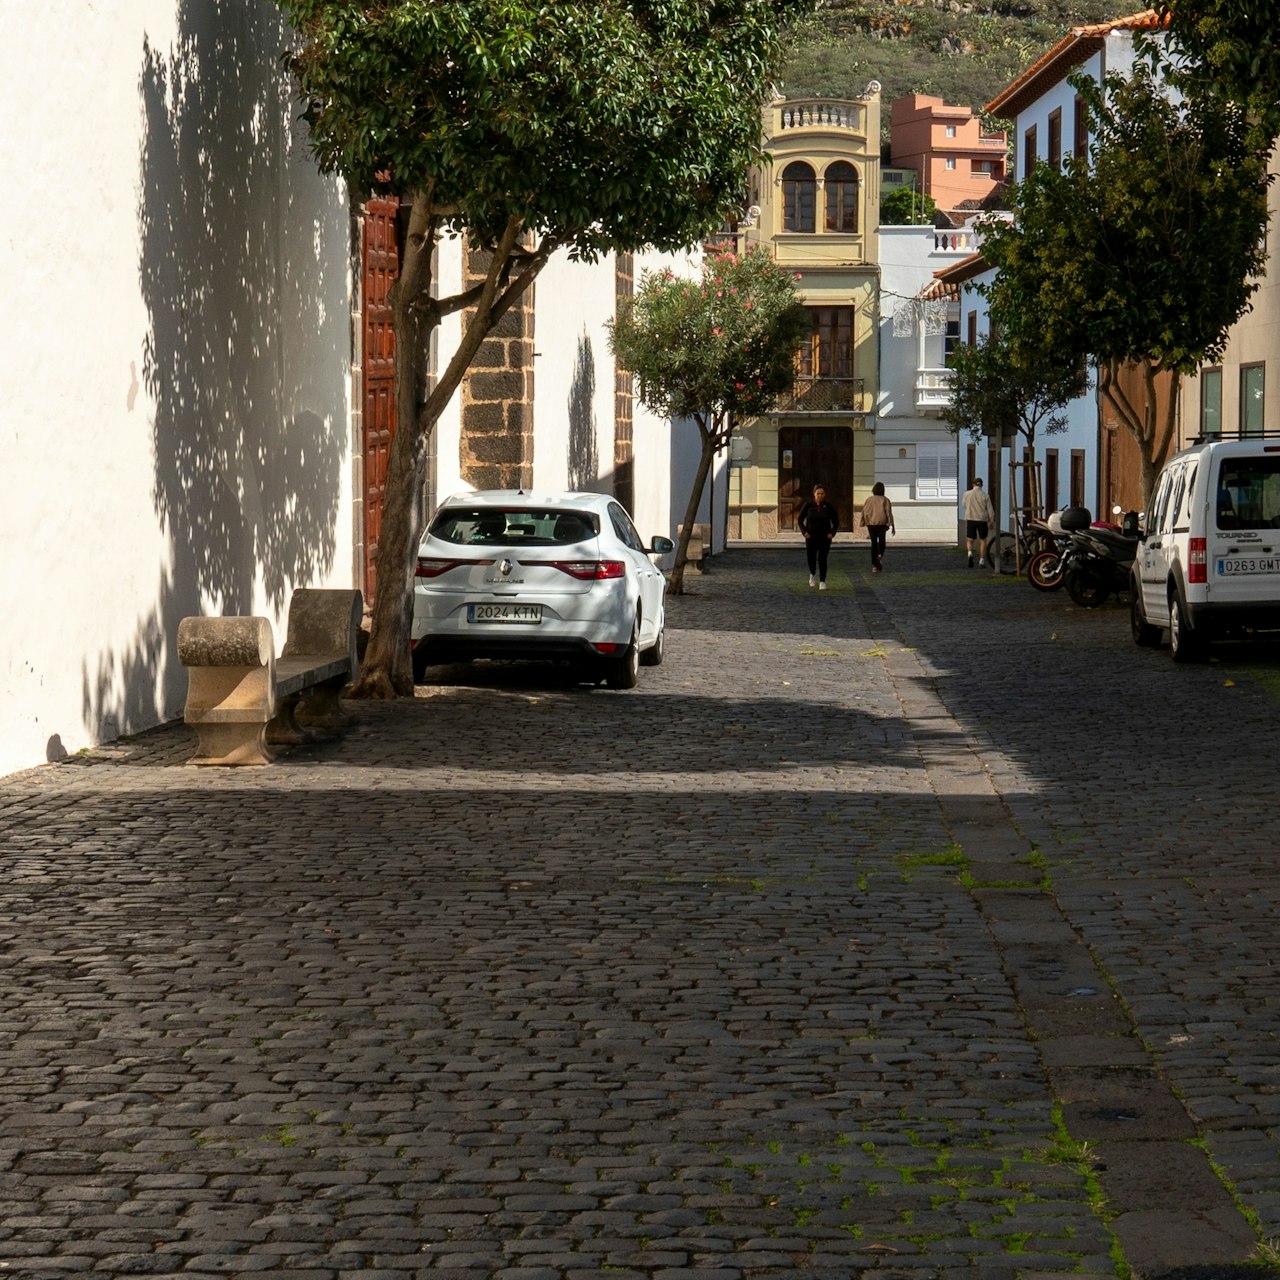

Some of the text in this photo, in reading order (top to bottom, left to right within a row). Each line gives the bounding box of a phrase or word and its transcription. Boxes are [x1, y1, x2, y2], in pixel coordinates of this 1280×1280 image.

[1226, 560, 1280, 571] 0263 GMT
[477, 607, 538, 619] 2024 KTN
